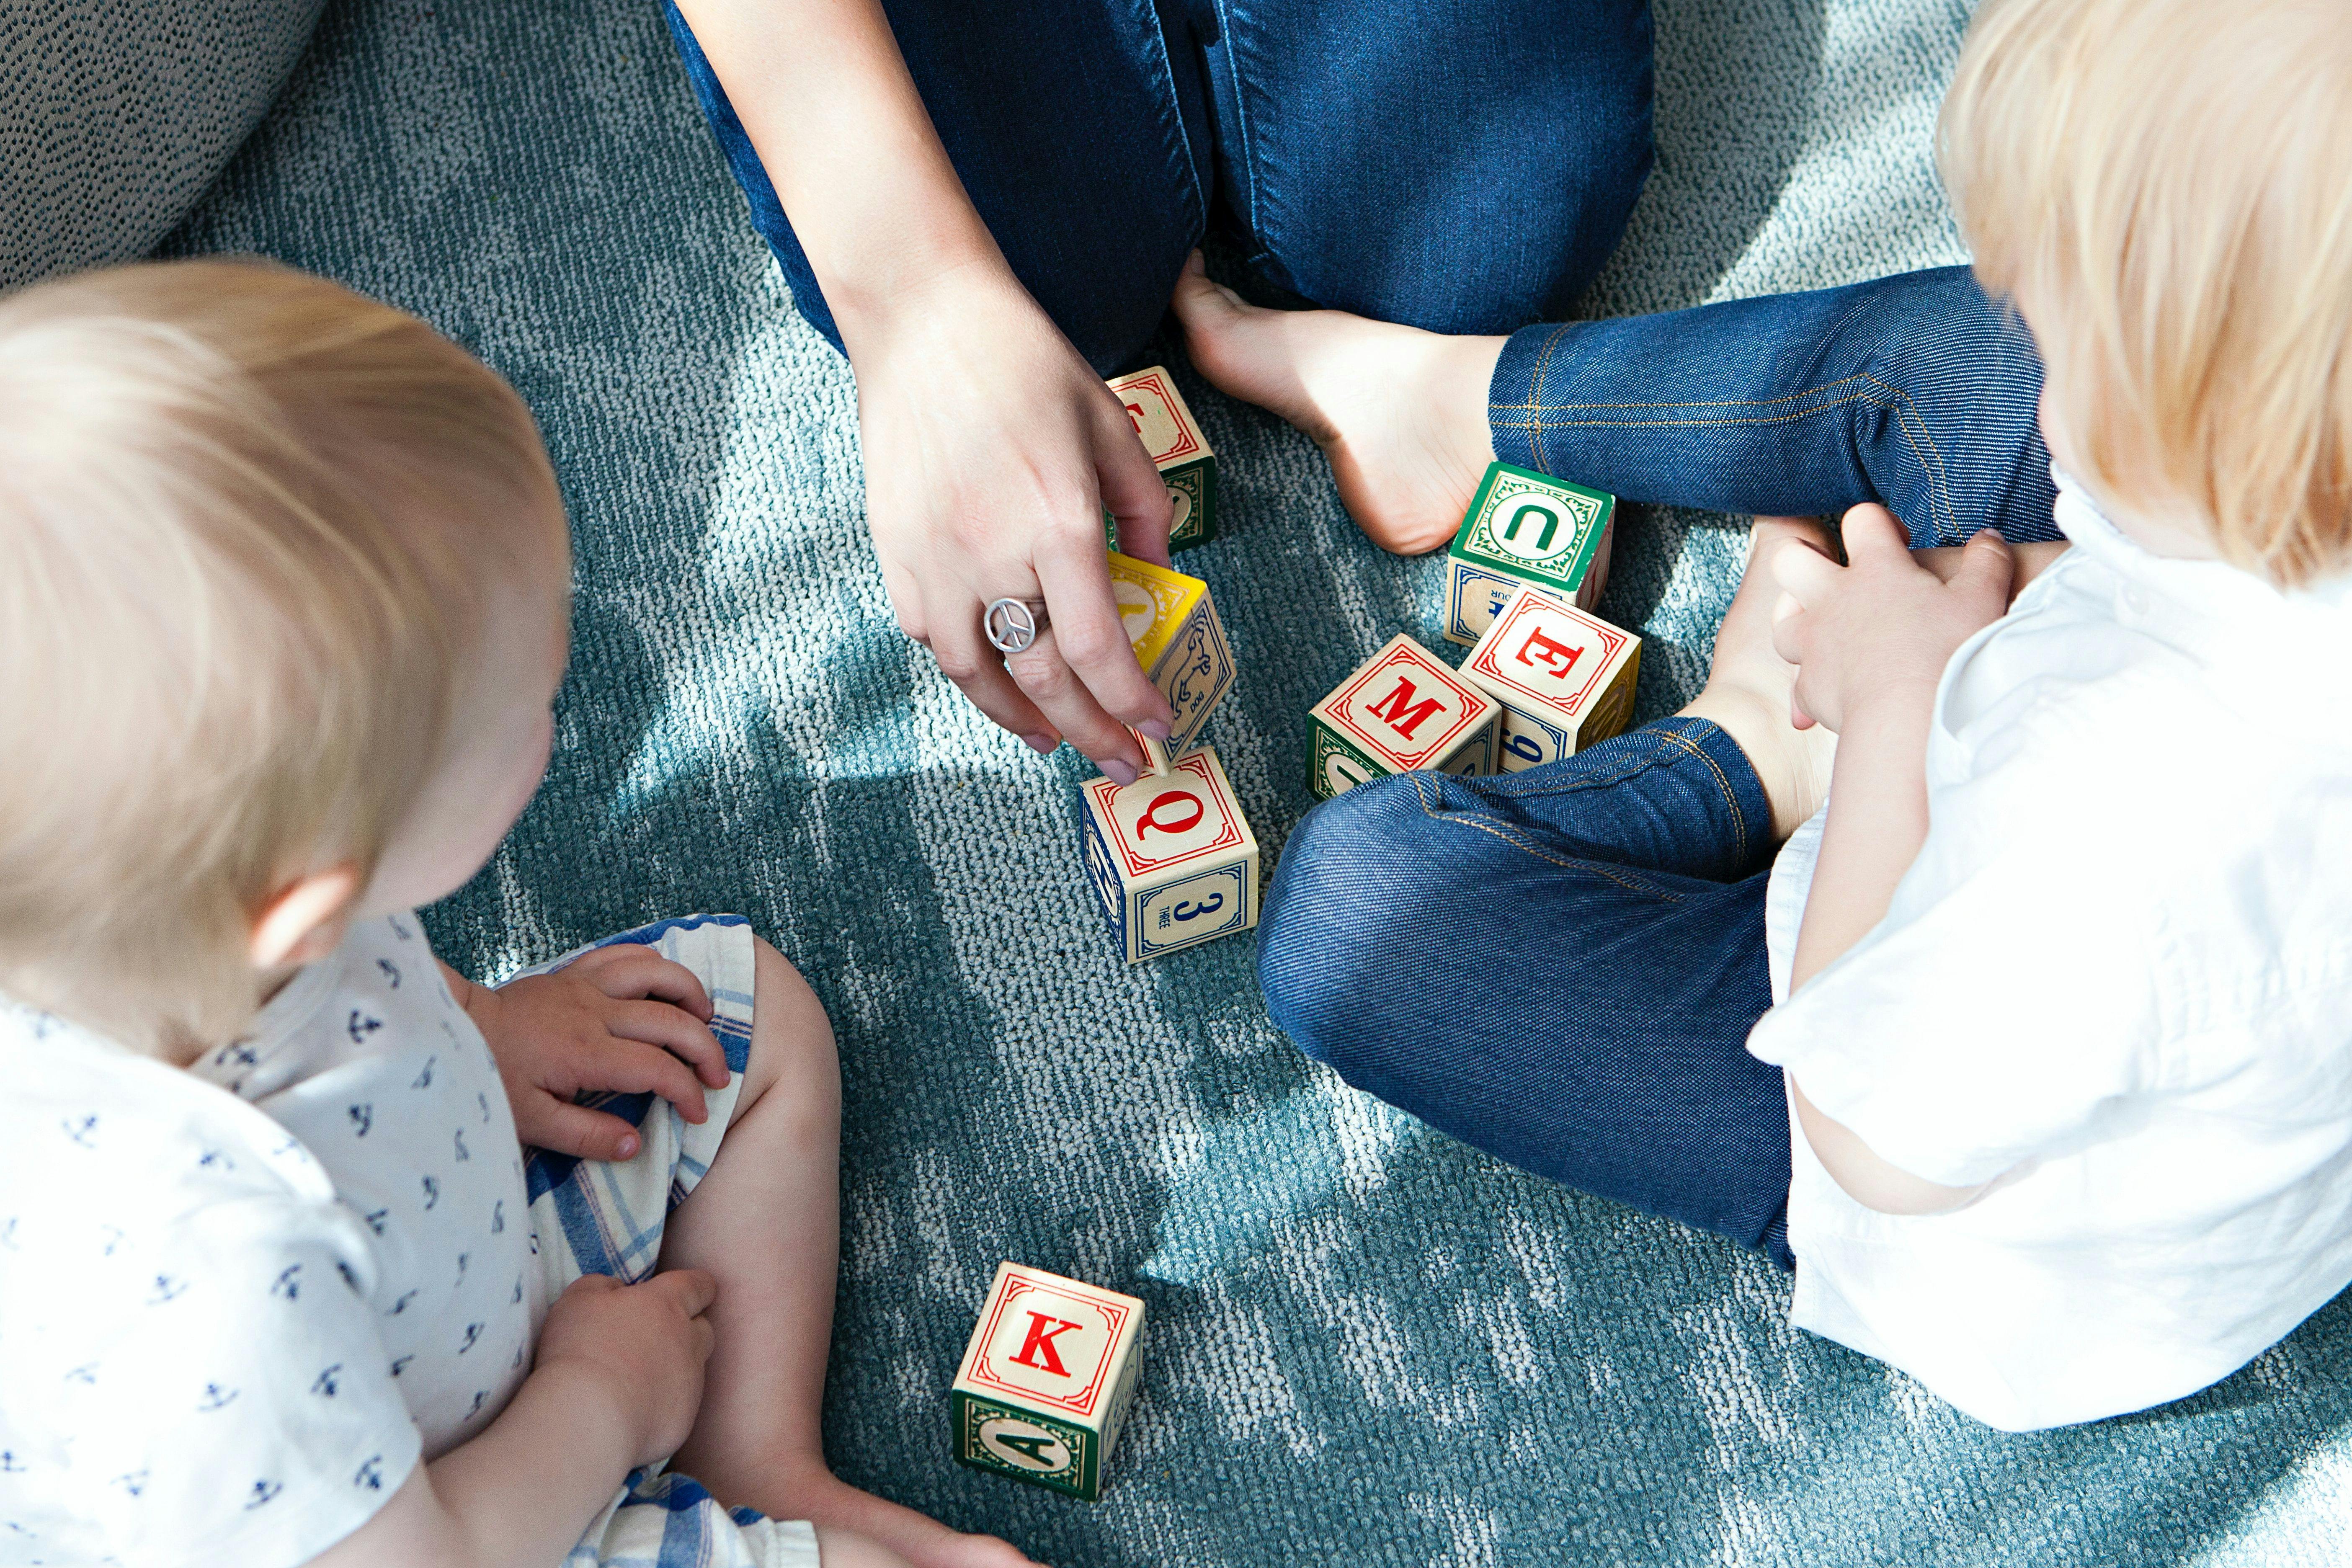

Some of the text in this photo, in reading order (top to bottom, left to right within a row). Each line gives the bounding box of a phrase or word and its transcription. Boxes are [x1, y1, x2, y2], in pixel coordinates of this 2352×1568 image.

[1503, 504, 1559, 552] U
[1491, 589, 1511, 601] OUR
[1516, 627, 1584, 679] E
[1190, 691, 1204, 714] DOG
[1365, 675, 1447, 741] M
[1136, 791, 1204, 841] Q
[1159, 905, 1170, 930] THREE
[1173, 892, 1223, 921] 3
[1009, 1310, 1083, 1378] K
[995, 1434, 1055, 1467] A
